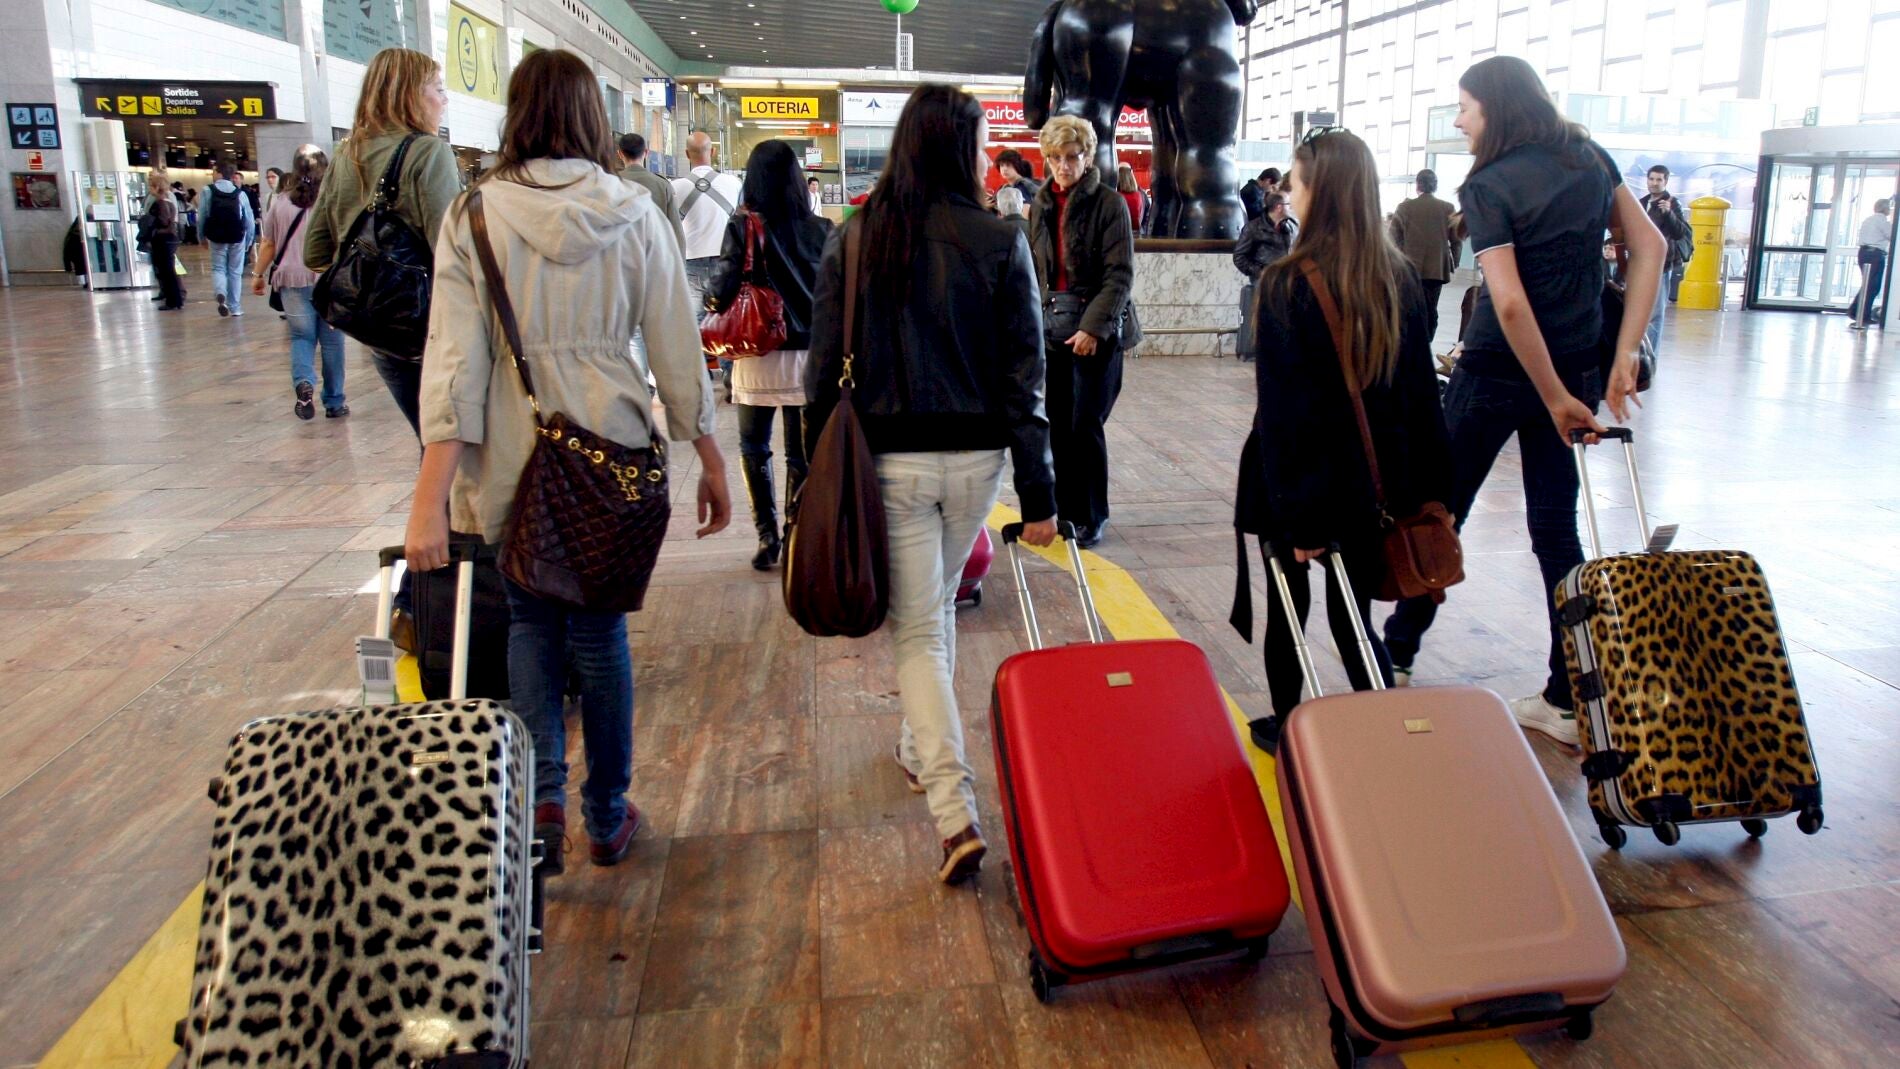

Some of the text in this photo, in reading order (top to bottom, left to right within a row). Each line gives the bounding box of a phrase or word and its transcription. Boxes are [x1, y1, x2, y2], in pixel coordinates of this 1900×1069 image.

[164, 88, 199, 97] Sortides
[165, 97, 203, 106] Departures
[166, 106, 196, 114] Salidas
[748, 101, 810, 114] LOTERIA
